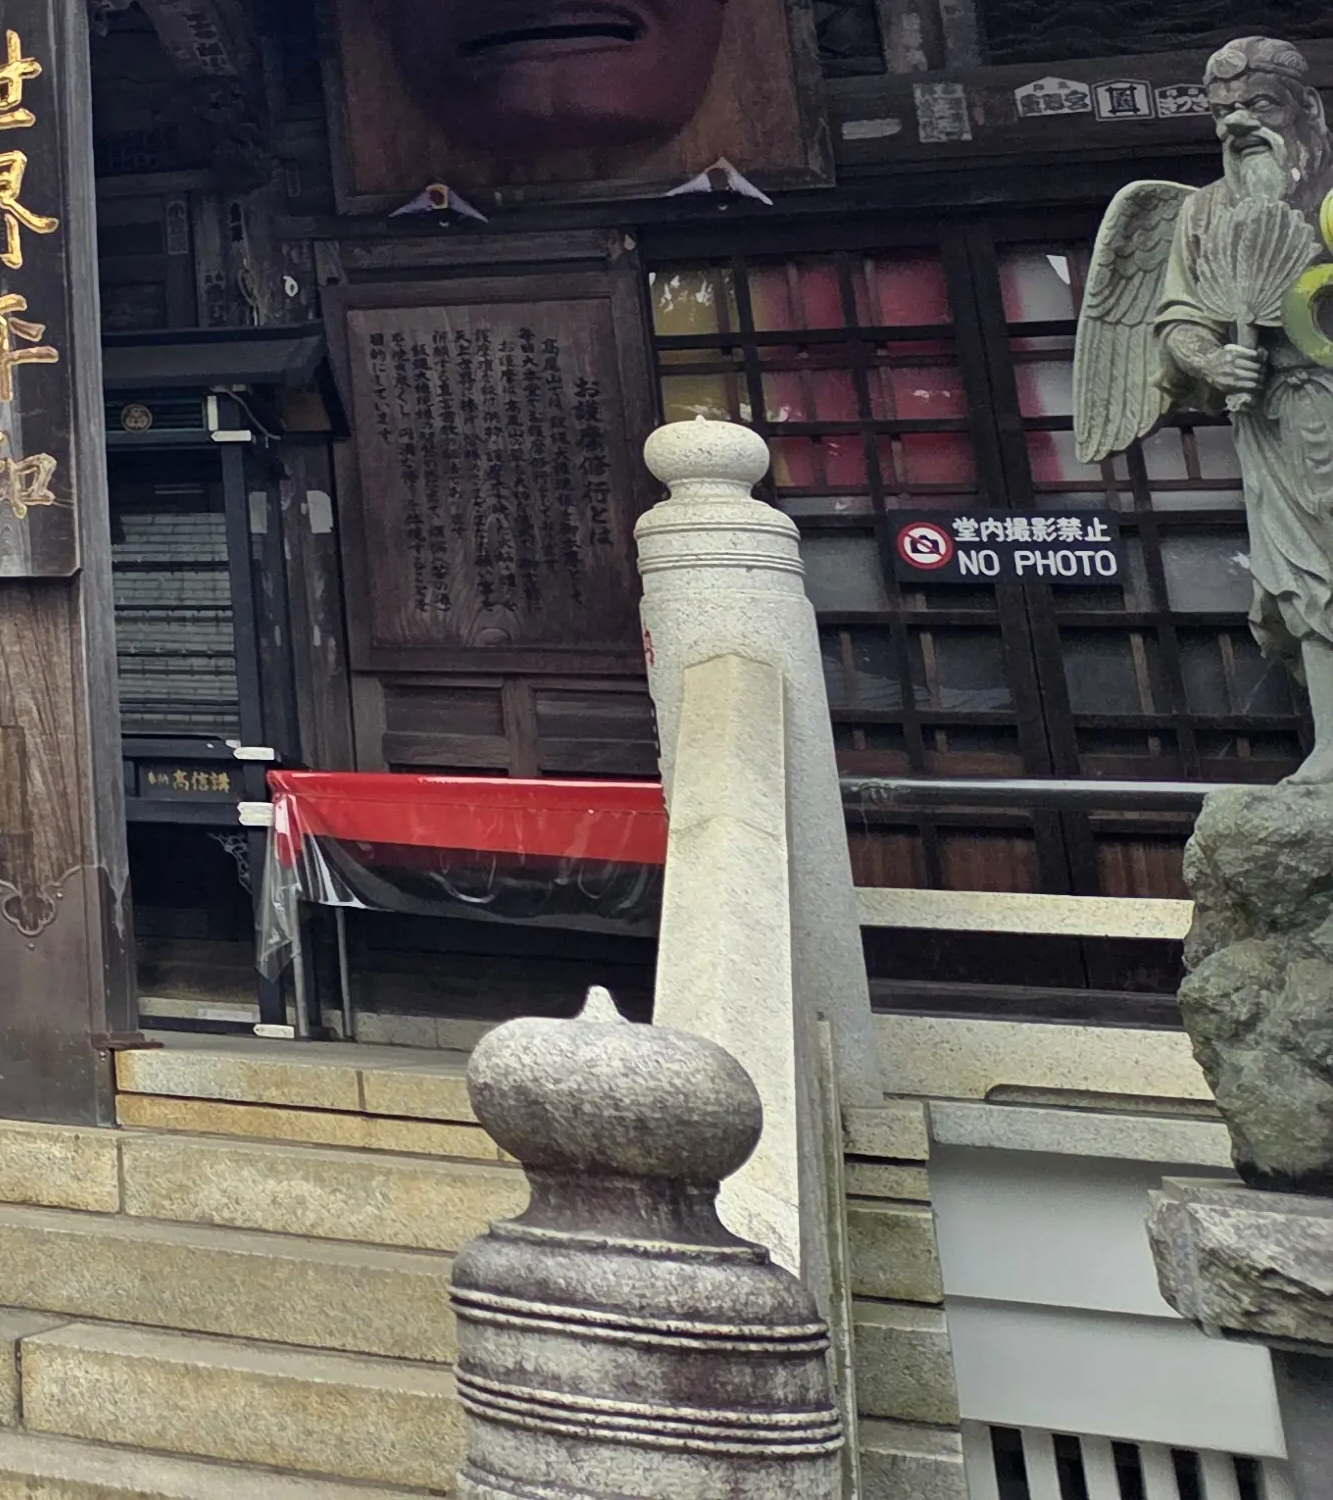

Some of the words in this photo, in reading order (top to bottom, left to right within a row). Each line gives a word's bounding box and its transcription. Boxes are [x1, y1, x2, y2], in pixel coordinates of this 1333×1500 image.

[951, 516, 1112, 543] 堂内撮影禁止
[957, 549, 1001, 577] NO
[1013, 549, 1118, 577] PHOTO
